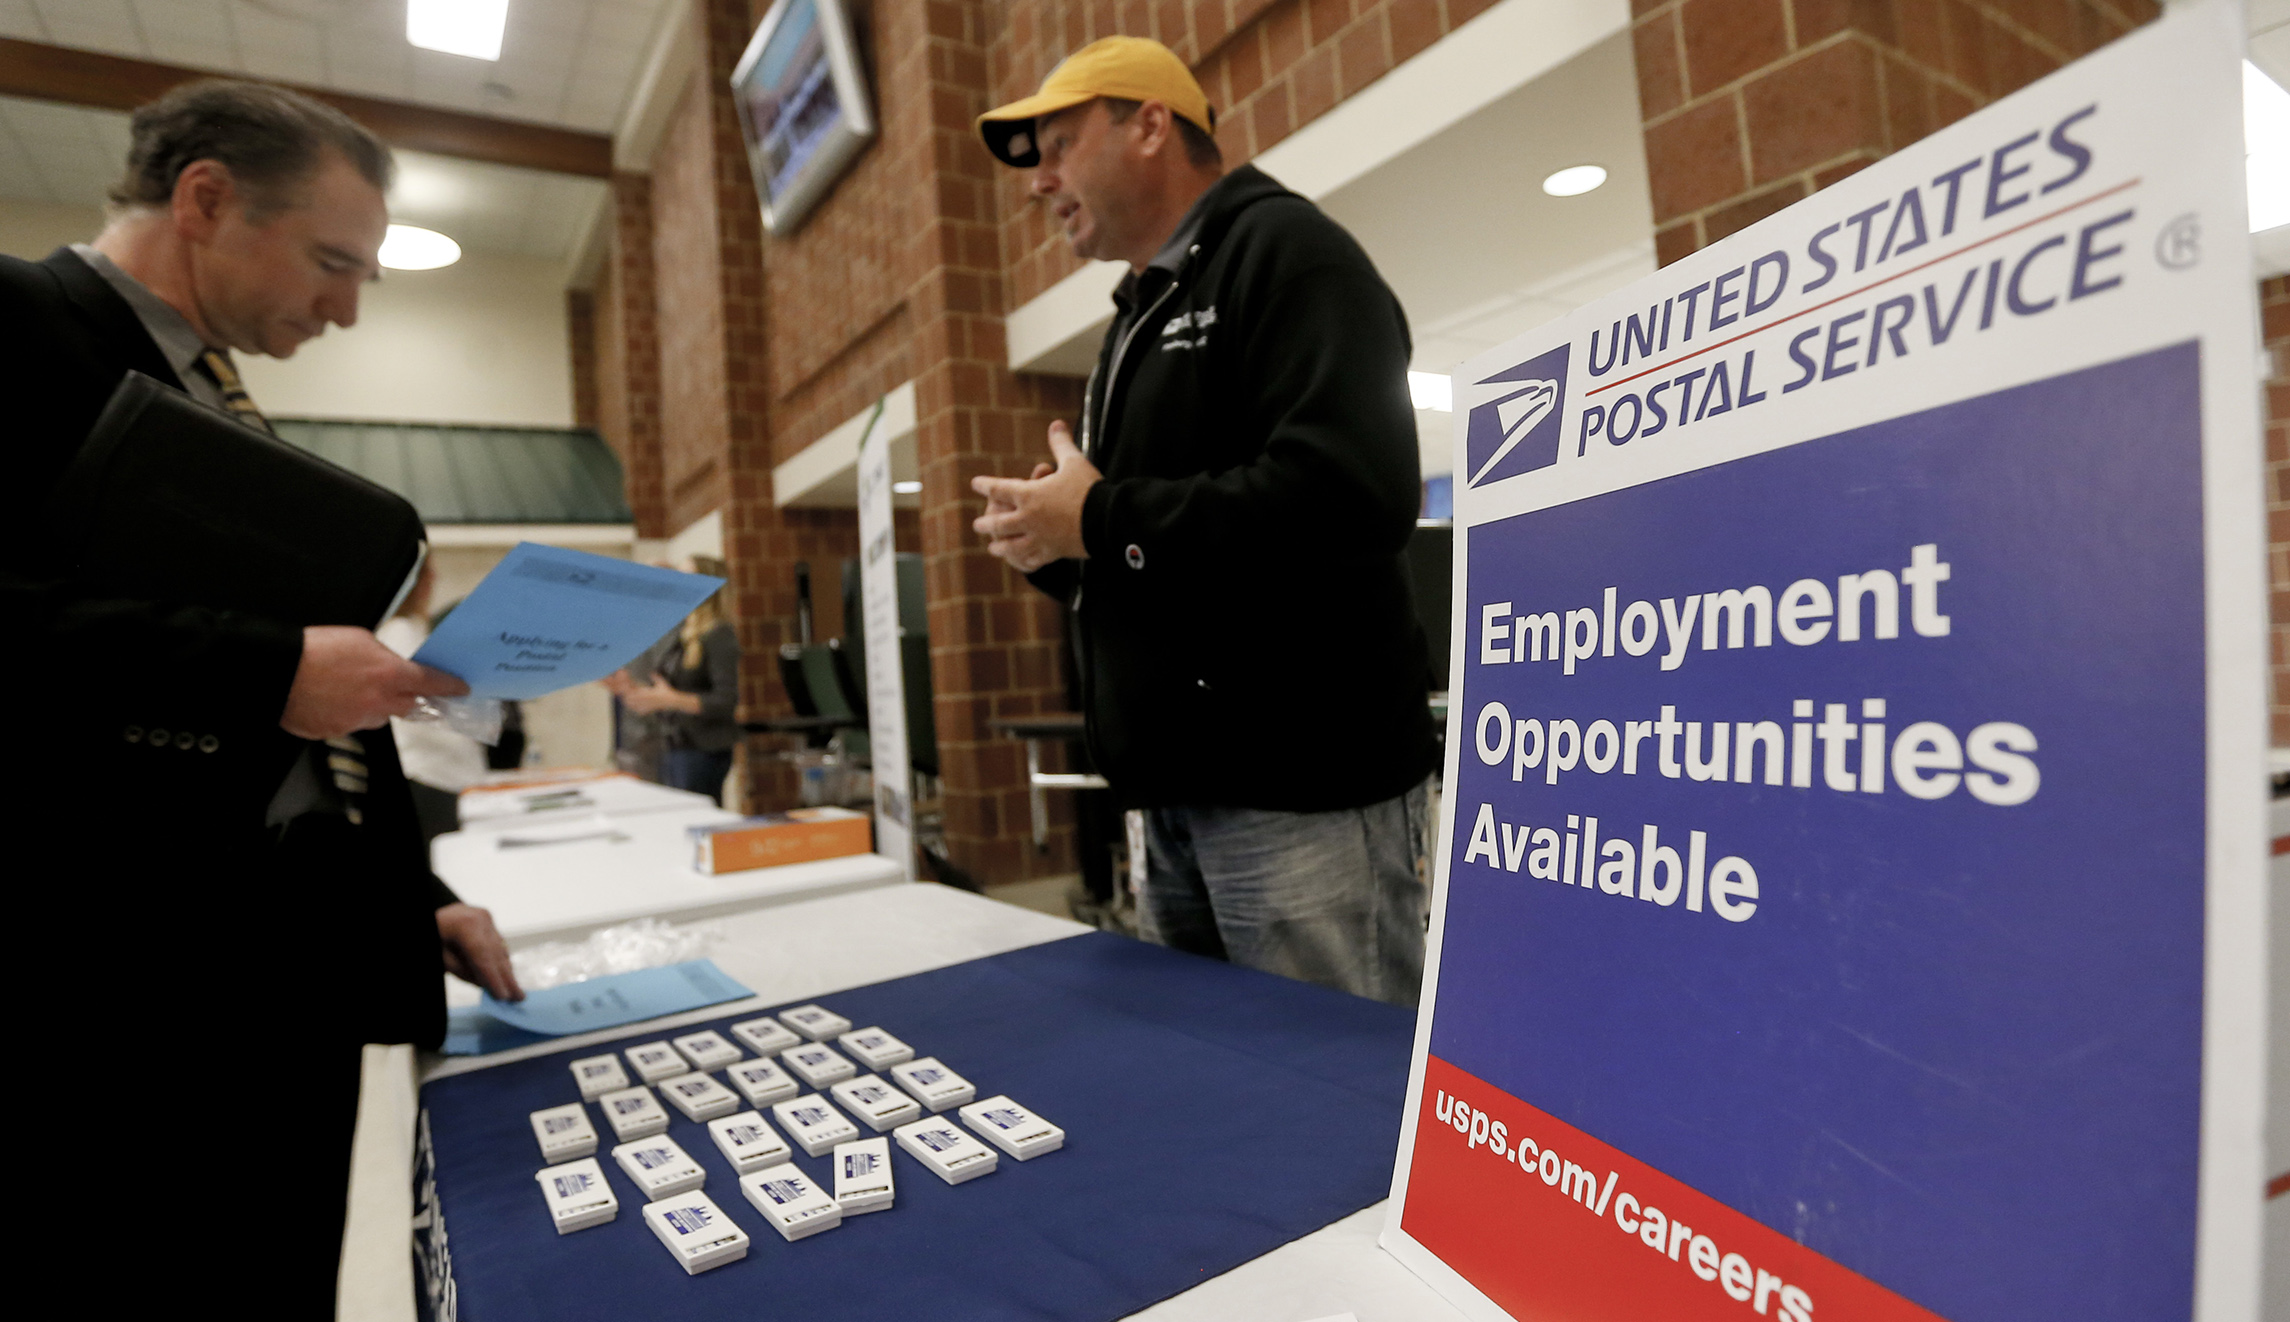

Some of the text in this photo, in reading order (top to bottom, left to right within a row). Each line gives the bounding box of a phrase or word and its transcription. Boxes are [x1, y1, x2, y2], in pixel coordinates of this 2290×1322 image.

[1578, 348, 1767, 457] POSTAL
[1782, 207, 2135, 394] SERVICE
[1587, 104, 2098, 377] UNITED STATES
[1480, 543, 1951, 676] Employment
[1475, 697, 2041, 806] Opportunities
[1463, 802, 1760, 923] Available
[1434, 1088, 1815, 1322] usps.com/careers
